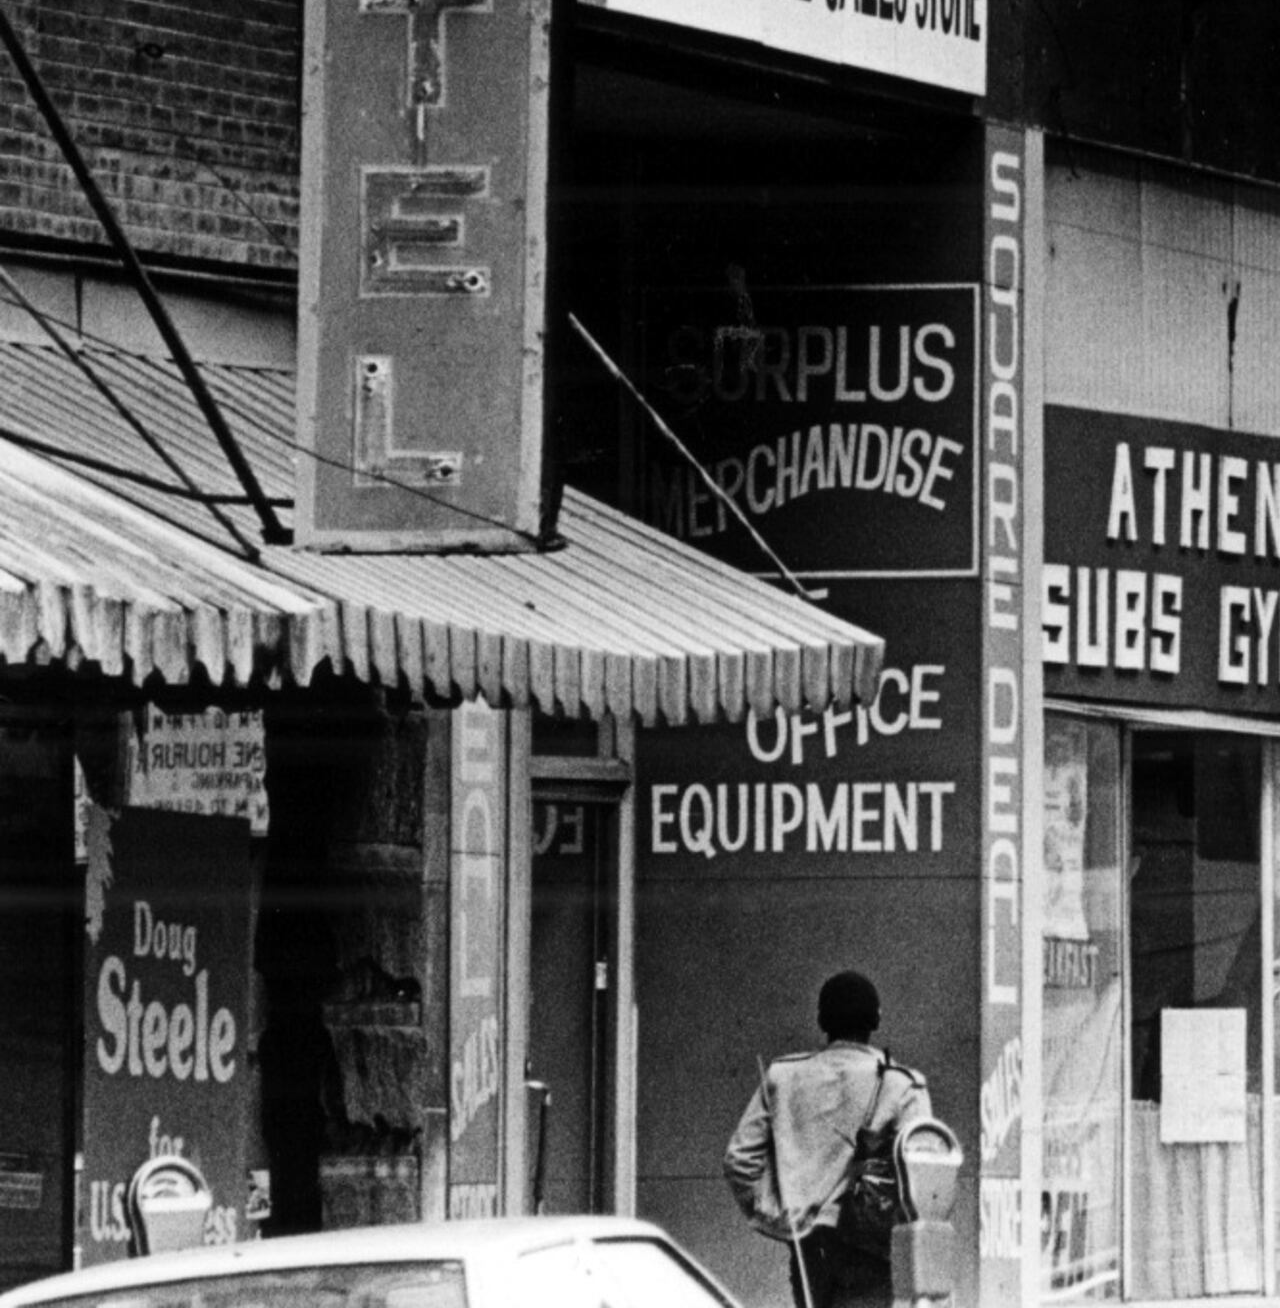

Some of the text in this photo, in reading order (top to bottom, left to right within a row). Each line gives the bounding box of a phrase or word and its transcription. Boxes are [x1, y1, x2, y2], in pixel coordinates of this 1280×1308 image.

[986, 151, 1021, 630] SQUARE
[651, 422, 966, 539] MERCHANDISE
[1041, 563, 1183, 674] SUBS
[746, 664, 946, 766] OFFICE
[650, 781, 956, 859] EQUIPMENT
[133, 900, 197, 977] Doug
[97, 955, 237, 1083] Steele
